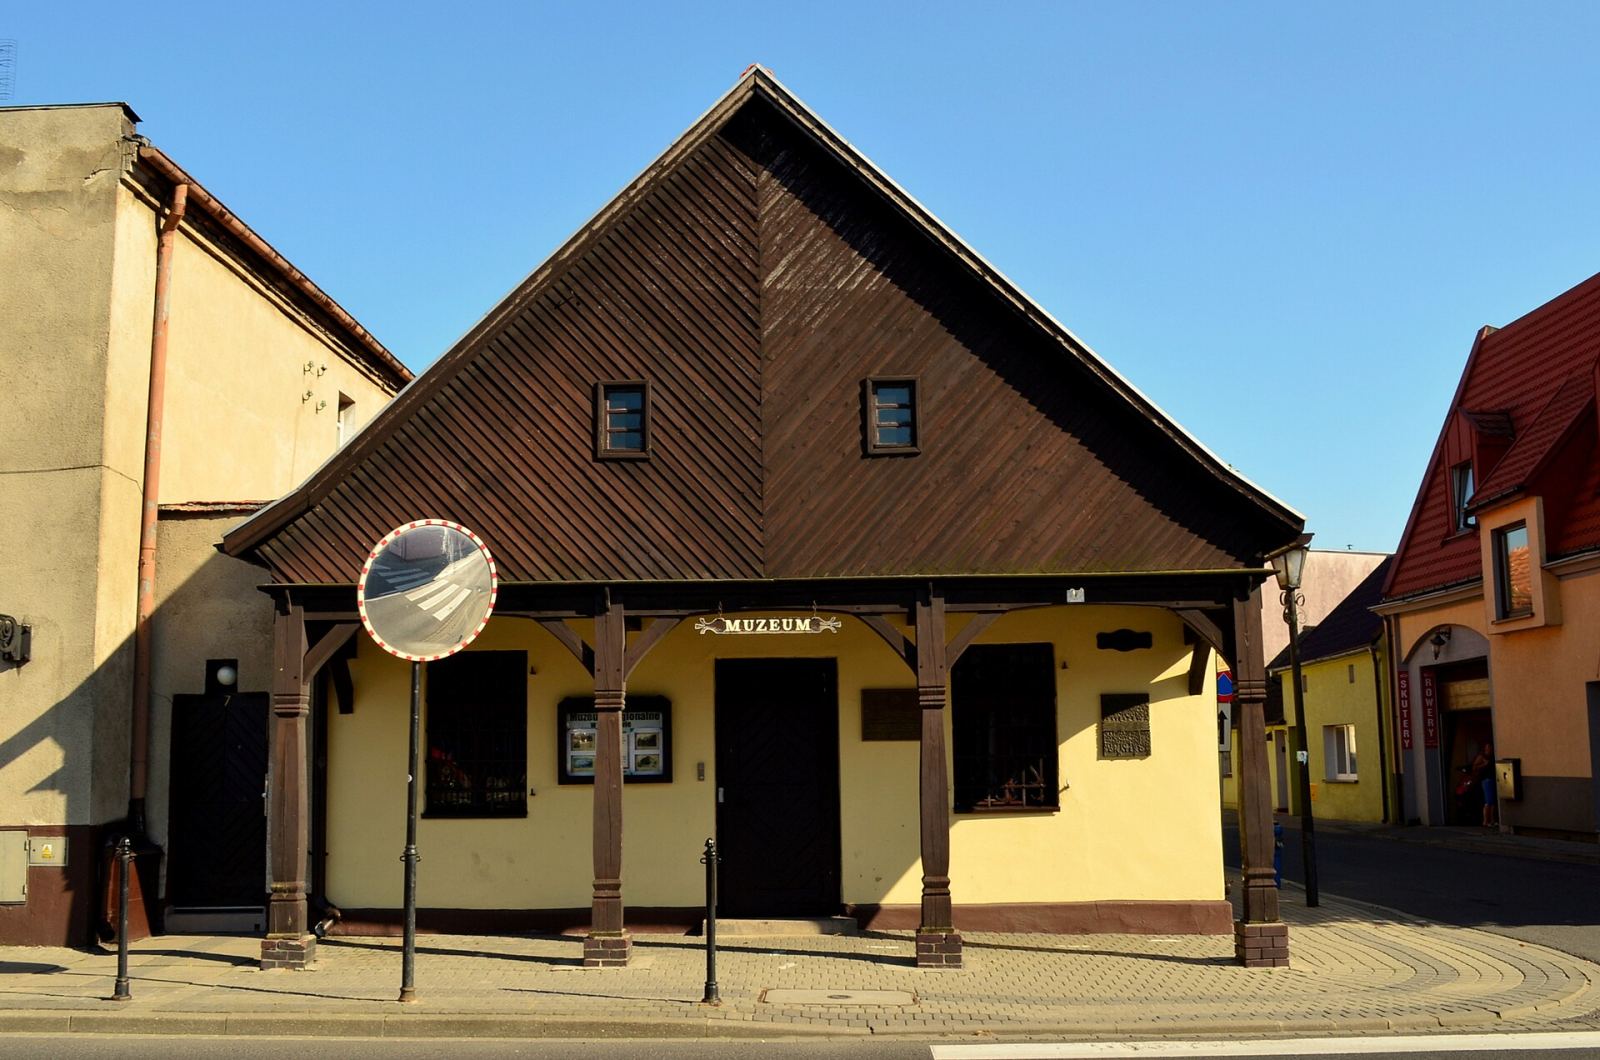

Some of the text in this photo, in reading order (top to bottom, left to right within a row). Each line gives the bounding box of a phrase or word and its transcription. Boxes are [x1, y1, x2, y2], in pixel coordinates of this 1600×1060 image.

[725, 618, 811, 632] MUZEUM
[1400, 679, 1410, 748] SKUTERY
[1425, 678, 1434, 737] ROWERY
